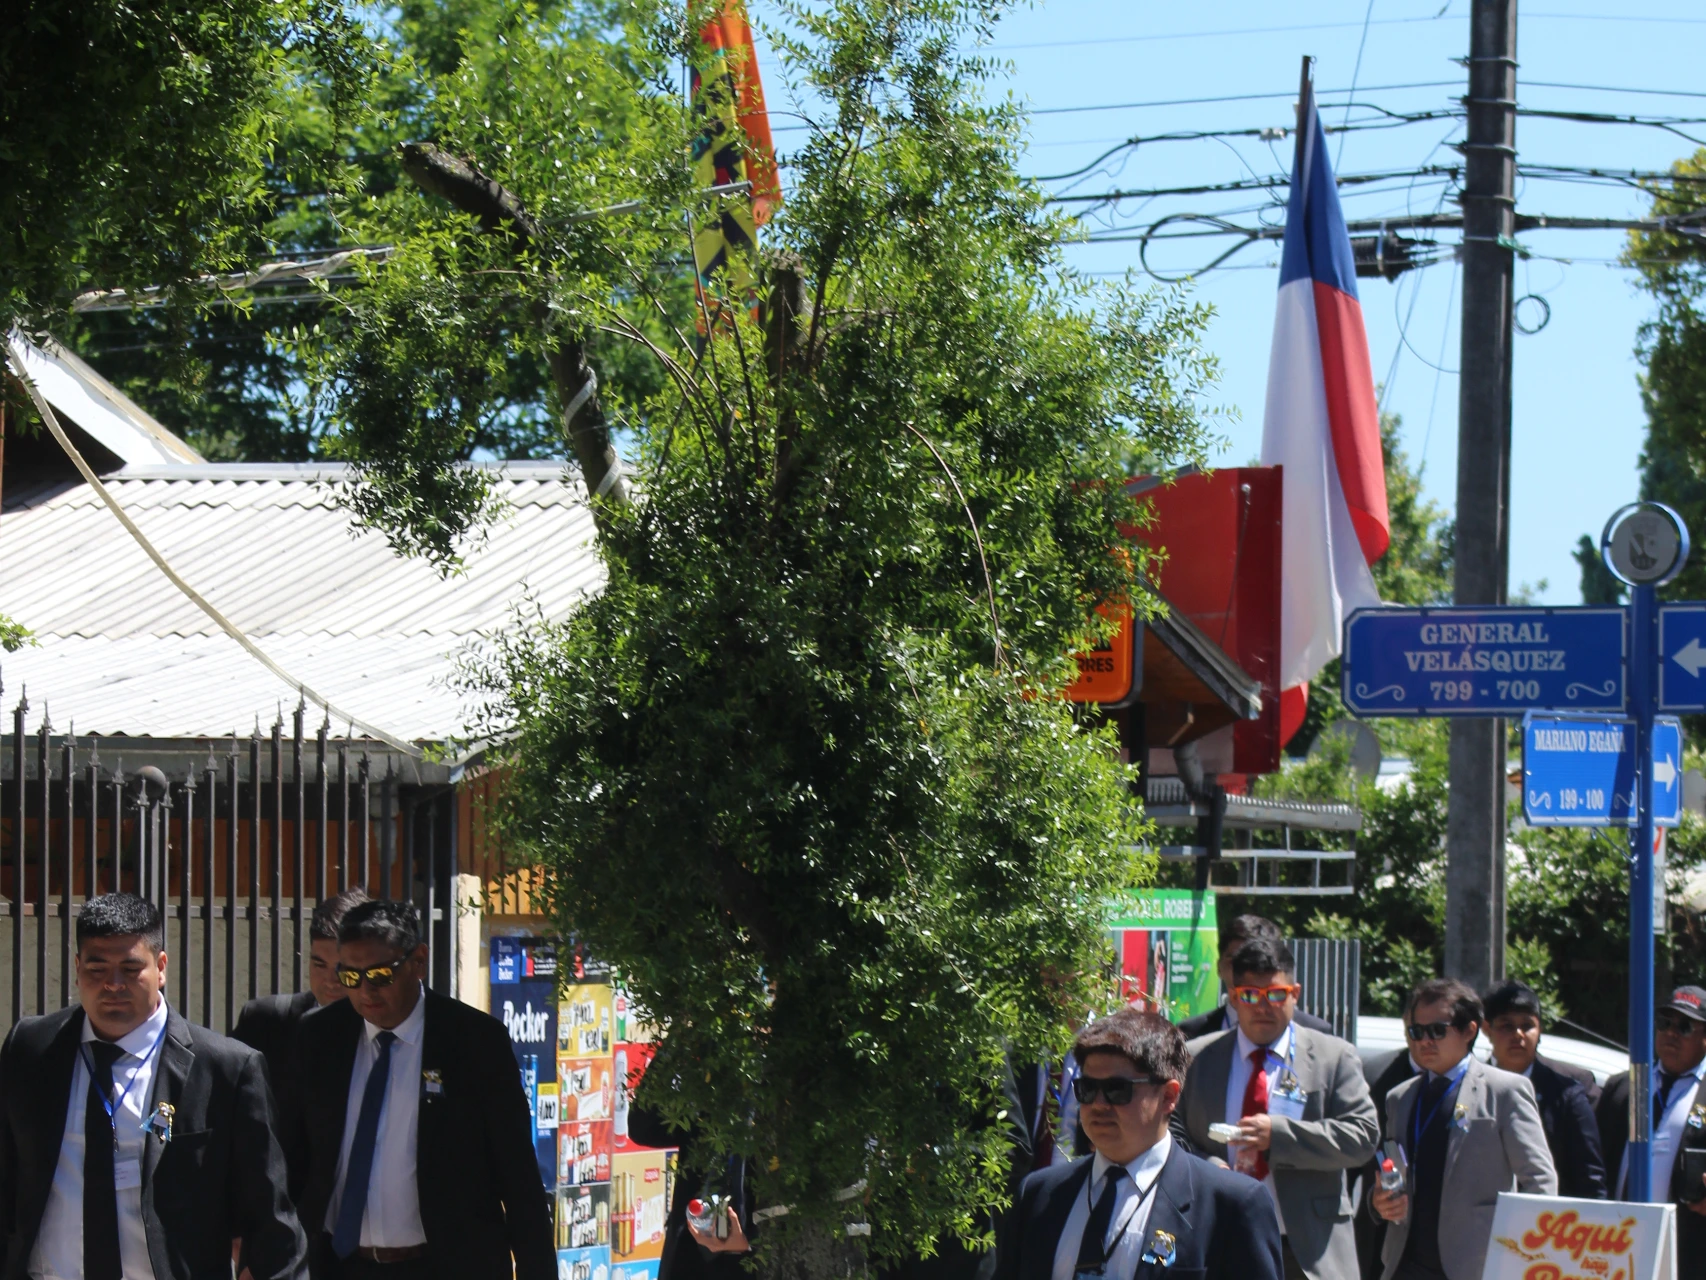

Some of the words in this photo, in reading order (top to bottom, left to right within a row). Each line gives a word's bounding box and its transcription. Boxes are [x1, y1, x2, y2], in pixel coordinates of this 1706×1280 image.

[1420, 623, 1549, 645] GENERAL
[1405, 644, 1566, 673] VELÁSQUEZ
[1430, 681, 1473, 700] 799
[1496, 680, 1540, 700] 700
[1534, 729, 1587, 752] MARIANO
[1588, 725, 1626, 753] EGAÑA
[1559, 788, 1578, 810] 199
[1586, 788, 1604, 810] 100
[503, 1000, 549, 1043] Becker
[1523, 1210, 1636, 1260] Aquí
